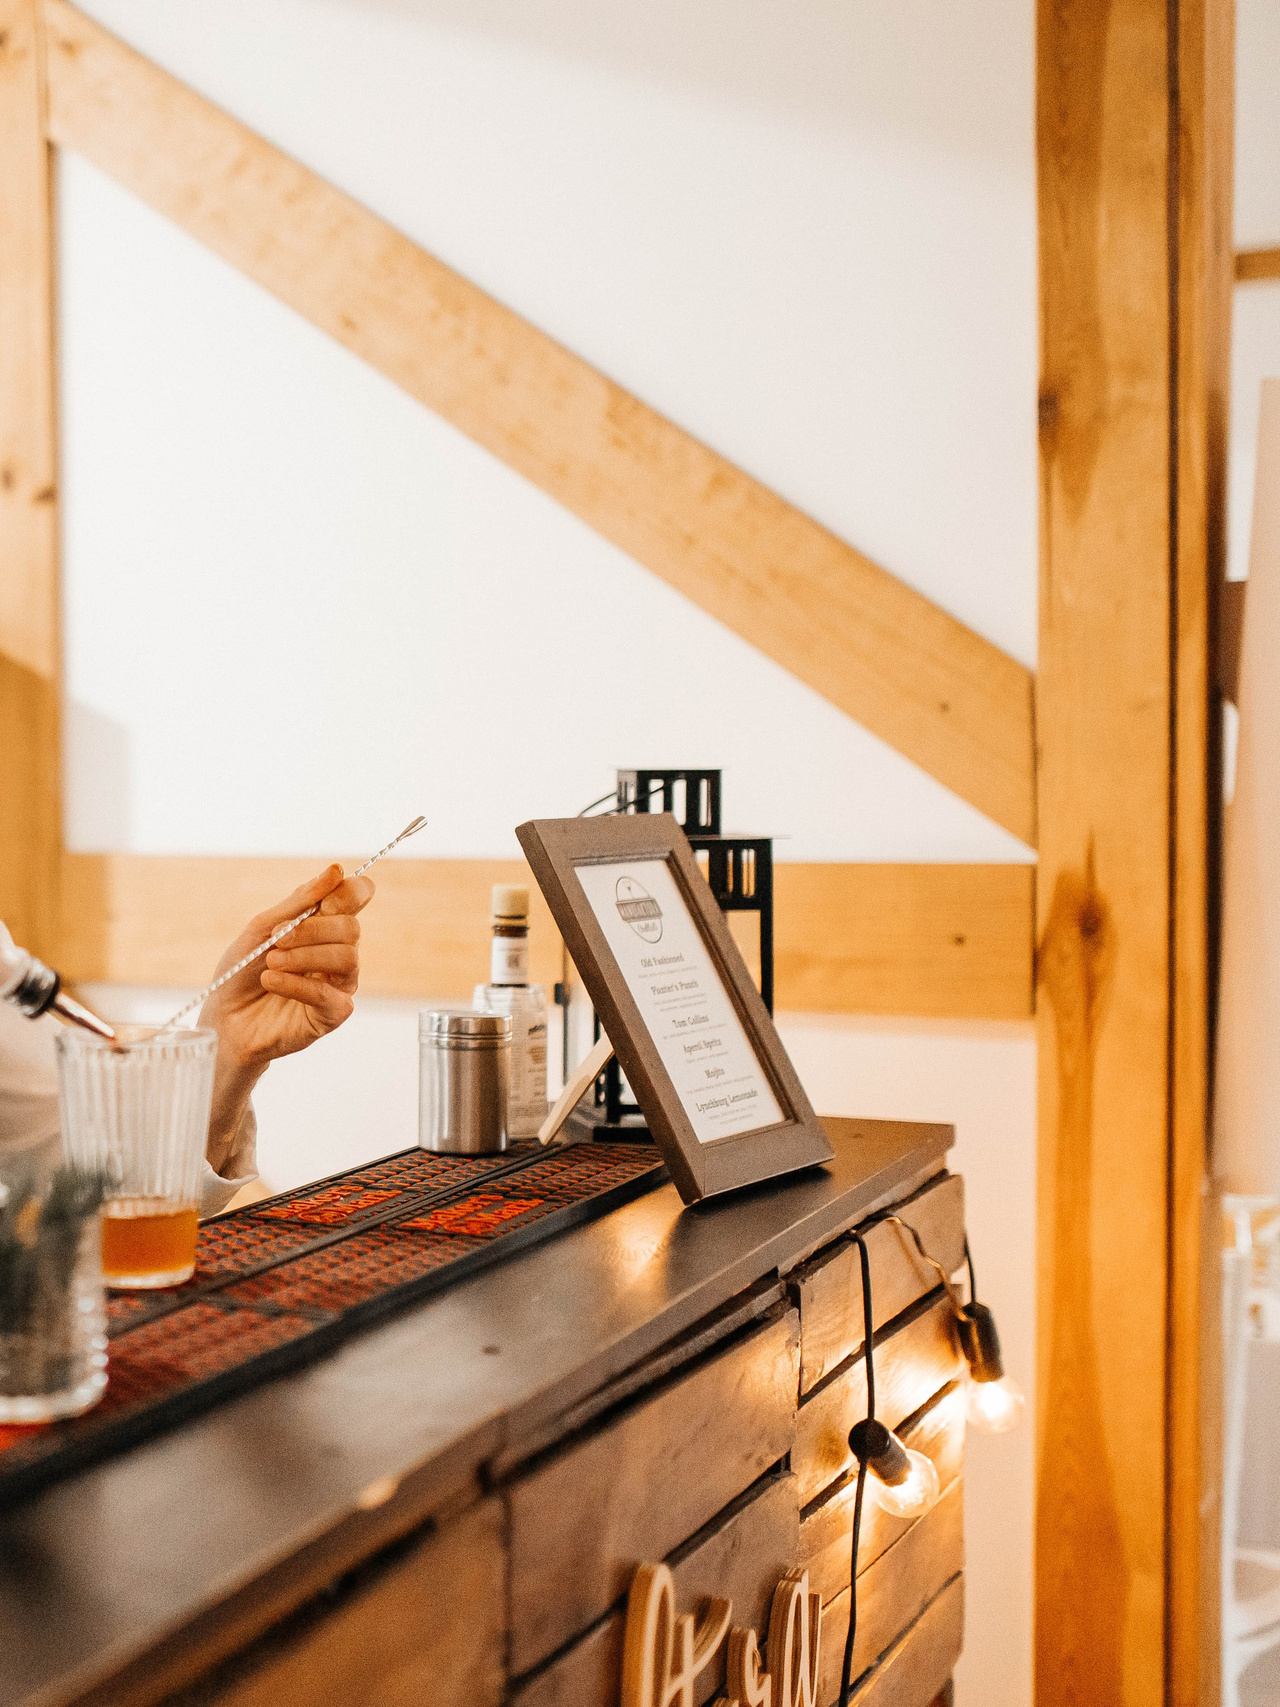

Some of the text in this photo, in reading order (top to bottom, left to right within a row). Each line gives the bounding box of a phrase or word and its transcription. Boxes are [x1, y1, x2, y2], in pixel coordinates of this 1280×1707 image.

[640, 952, 685, 968] Old Fashioned
[672, 1014, 710, 1029] Tom Collins
[695, 1097, 730, 1113] Lynchburg
[727, 1089, 759, 1104] Lemonade
